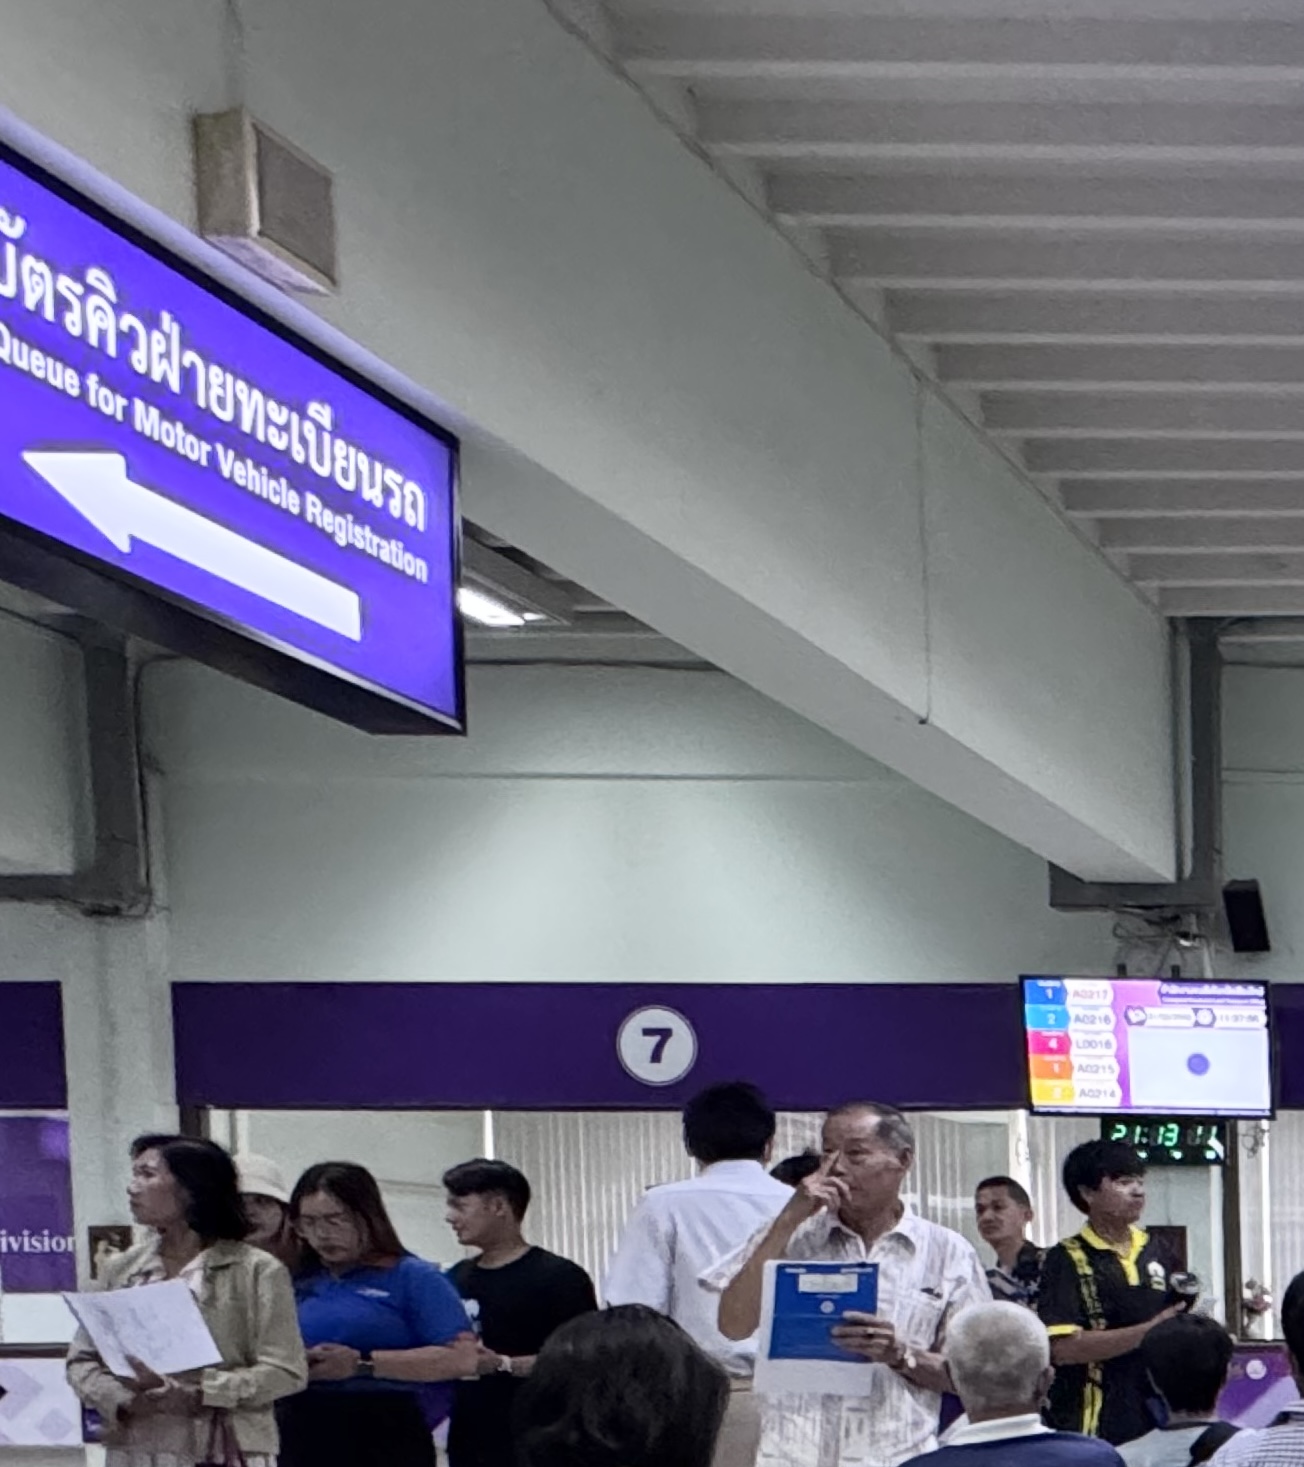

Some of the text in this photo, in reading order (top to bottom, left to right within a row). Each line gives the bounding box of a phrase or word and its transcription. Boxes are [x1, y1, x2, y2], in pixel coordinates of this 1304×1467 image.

[86, 373, 129, 422] for
[133, 397, 211, 467] Motor
[215, 442, 300, 516] Vehicle
[305, 490, 428, 585] Registration
[642, 1027, 673, 1064] 7
